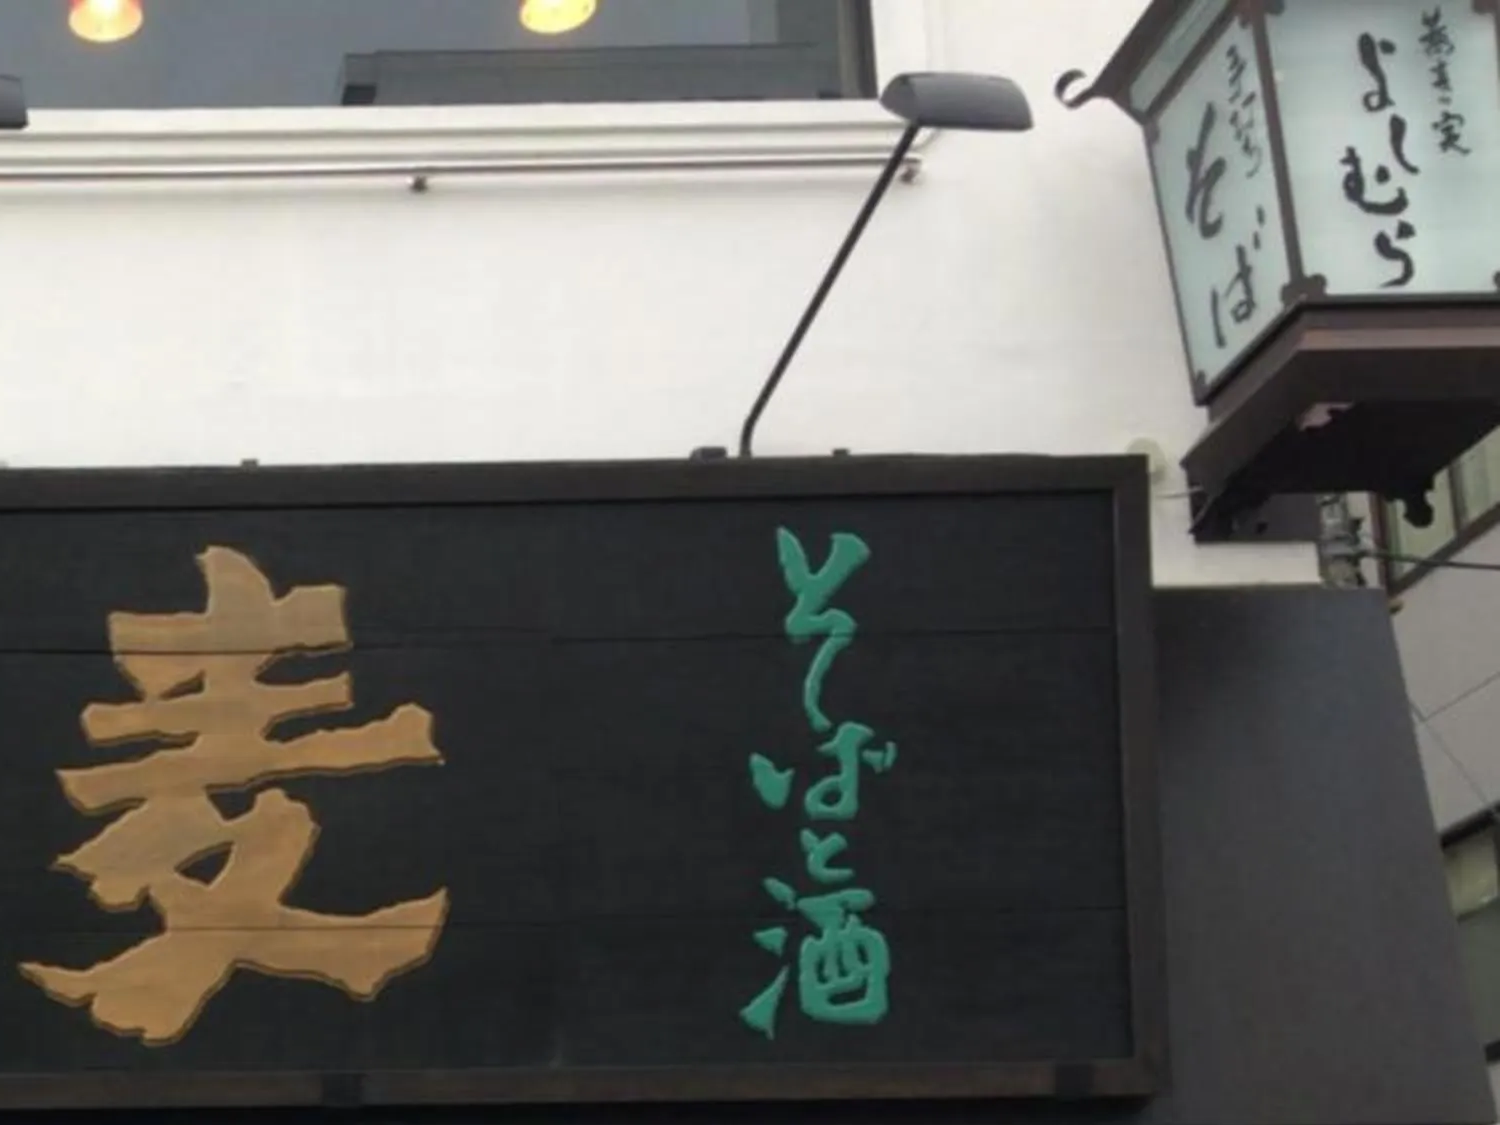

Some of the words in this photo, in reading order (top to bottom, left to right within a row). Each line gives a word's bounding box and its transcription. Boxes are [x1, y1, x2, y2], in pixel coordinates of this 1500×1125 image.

[1185, 102, 1265, 348] そば
[1340, 32, 1421, 287] よしむら
[740, 526, 896, 1039] そばと酒
